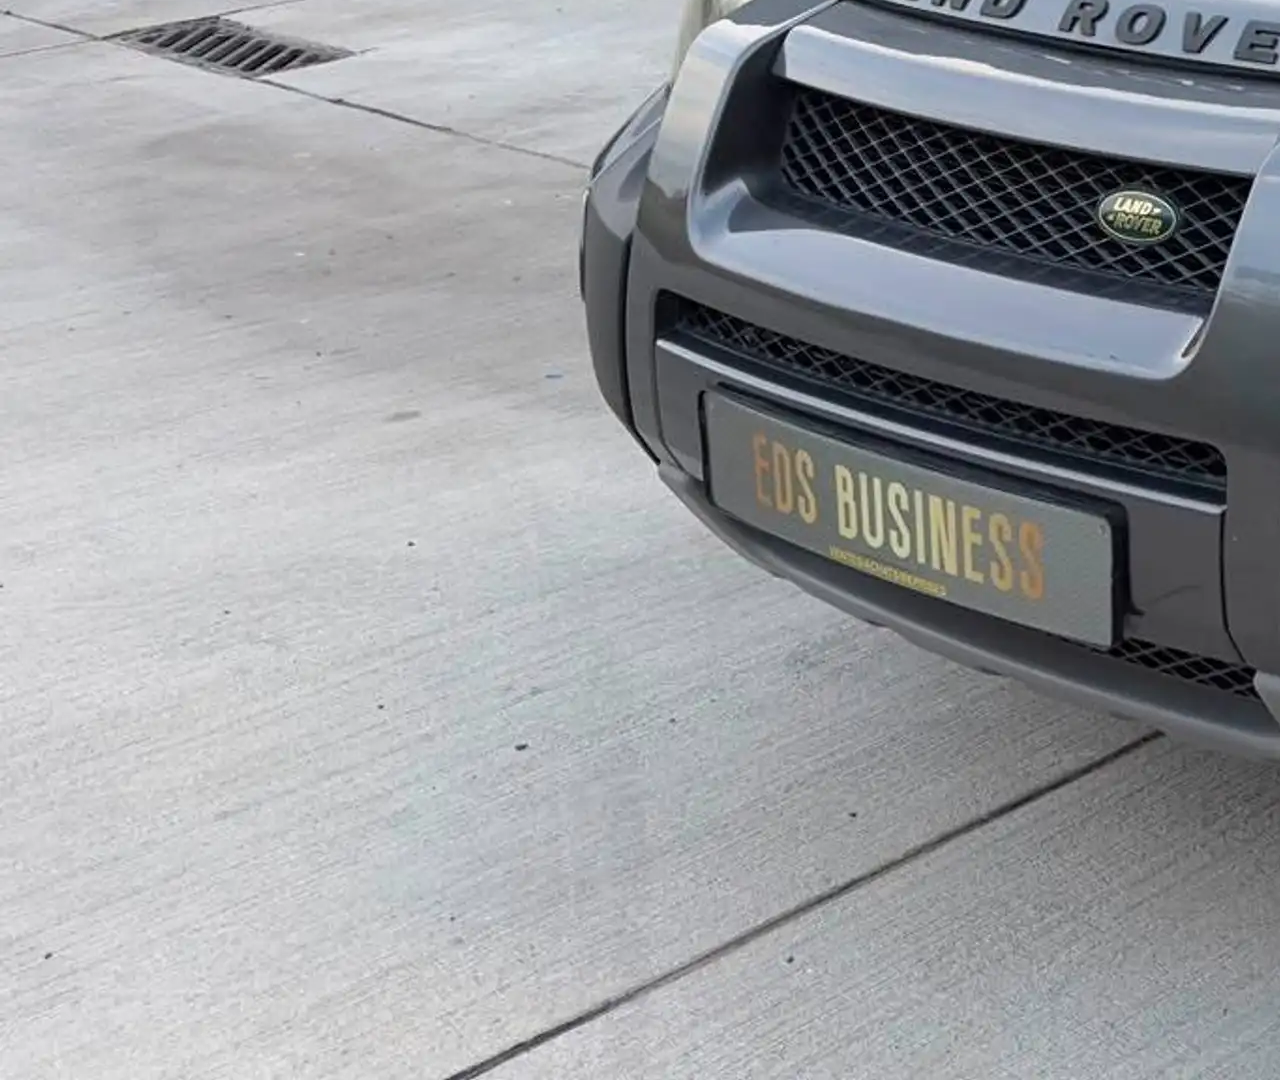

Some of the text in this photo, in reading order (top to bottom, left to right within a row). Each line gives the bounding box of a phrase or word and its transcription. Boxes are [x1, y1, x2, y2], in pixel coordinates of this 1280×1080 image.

[1114, 196, 1153, 216] LAND
[1113, 211, 1162, 236] ROVER
[752, 431, 818, 525] EDS
[834, 463, 1045, 601] BUSINESS
